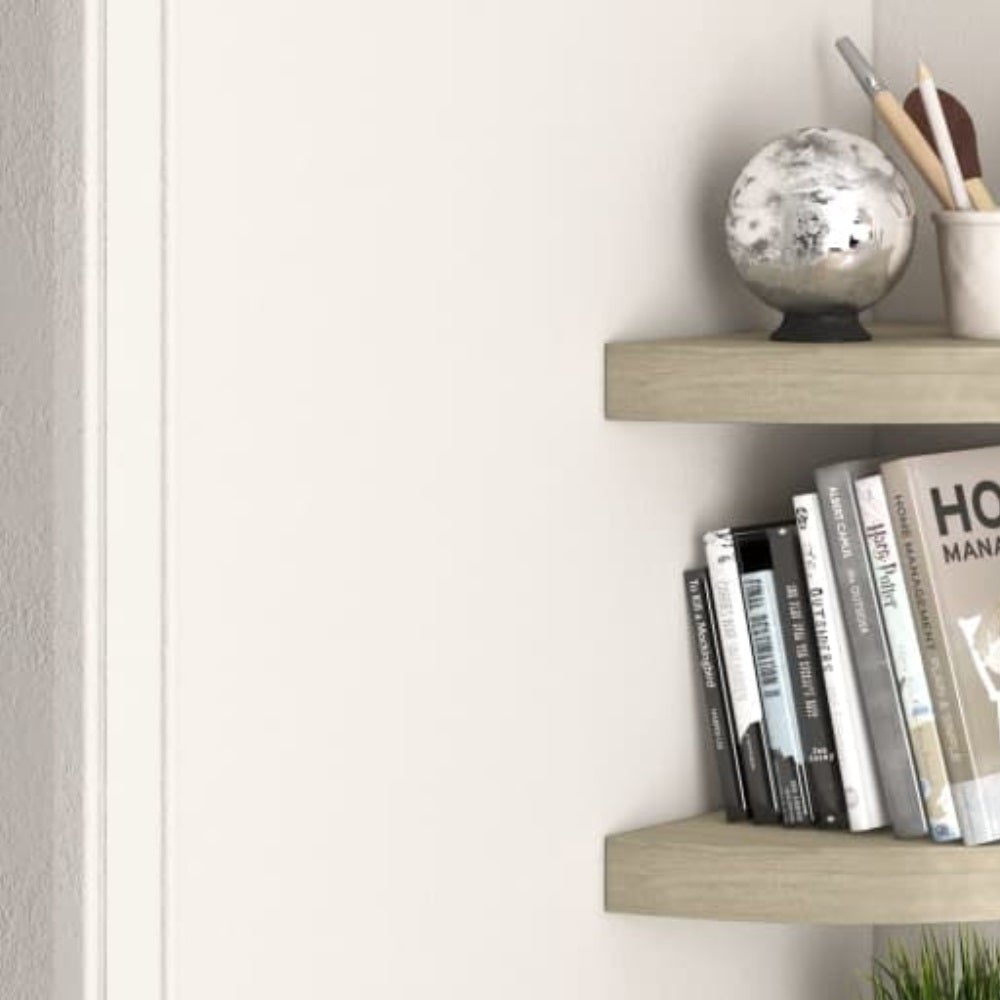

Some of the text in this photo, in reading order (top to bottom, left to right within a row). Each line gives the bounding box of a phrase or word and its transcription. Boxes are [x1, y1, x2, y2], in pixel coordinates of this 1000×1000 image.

[866, 523, 897, 610] Harry Potter
[893, 494, 911, 538] HOME
[904, 540, 936, 651] MANAGEMENT
[688, 578, 699, 592] To
[696, 620, 716, 689] Mockingbird
